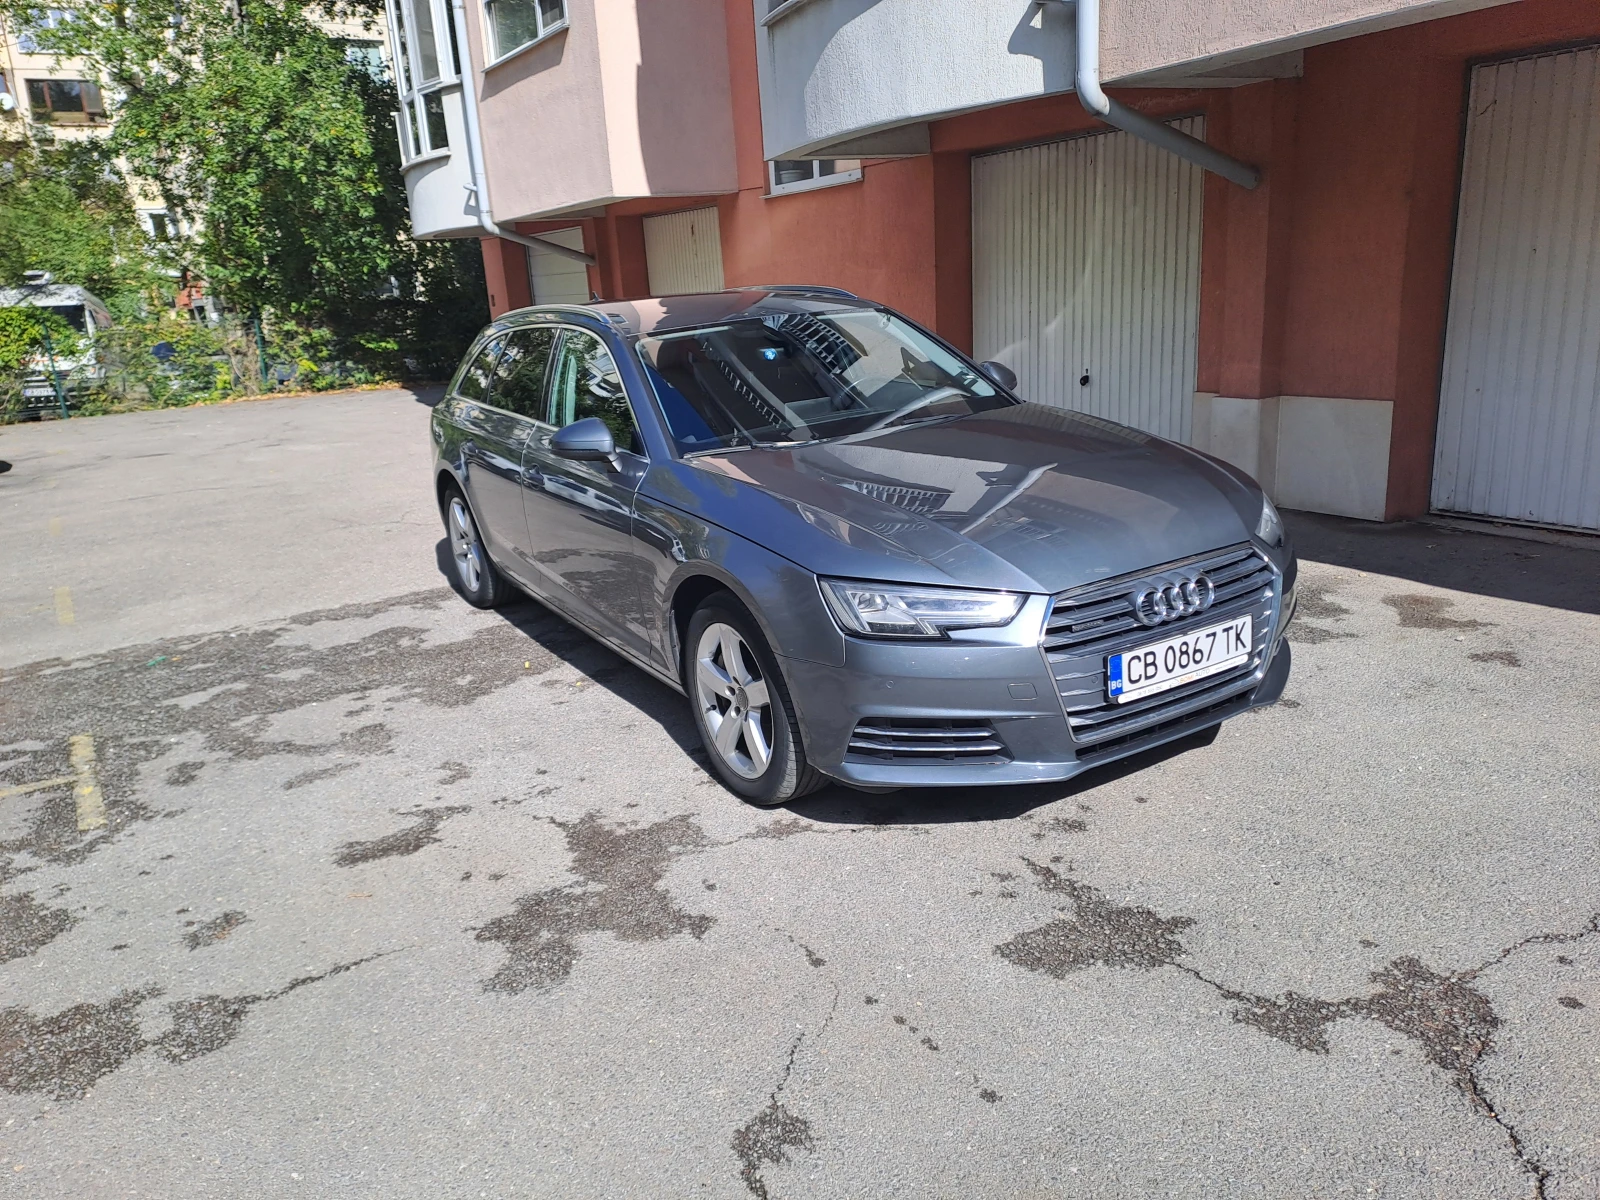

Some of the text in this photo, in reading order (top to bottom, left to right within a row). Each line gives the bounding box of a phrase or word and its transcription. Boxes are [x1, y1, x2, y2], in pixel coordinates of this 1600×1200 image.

[1127, 621, 1248, 684] CB 0867 TK
[1110, 679, 1122, 690] BG
